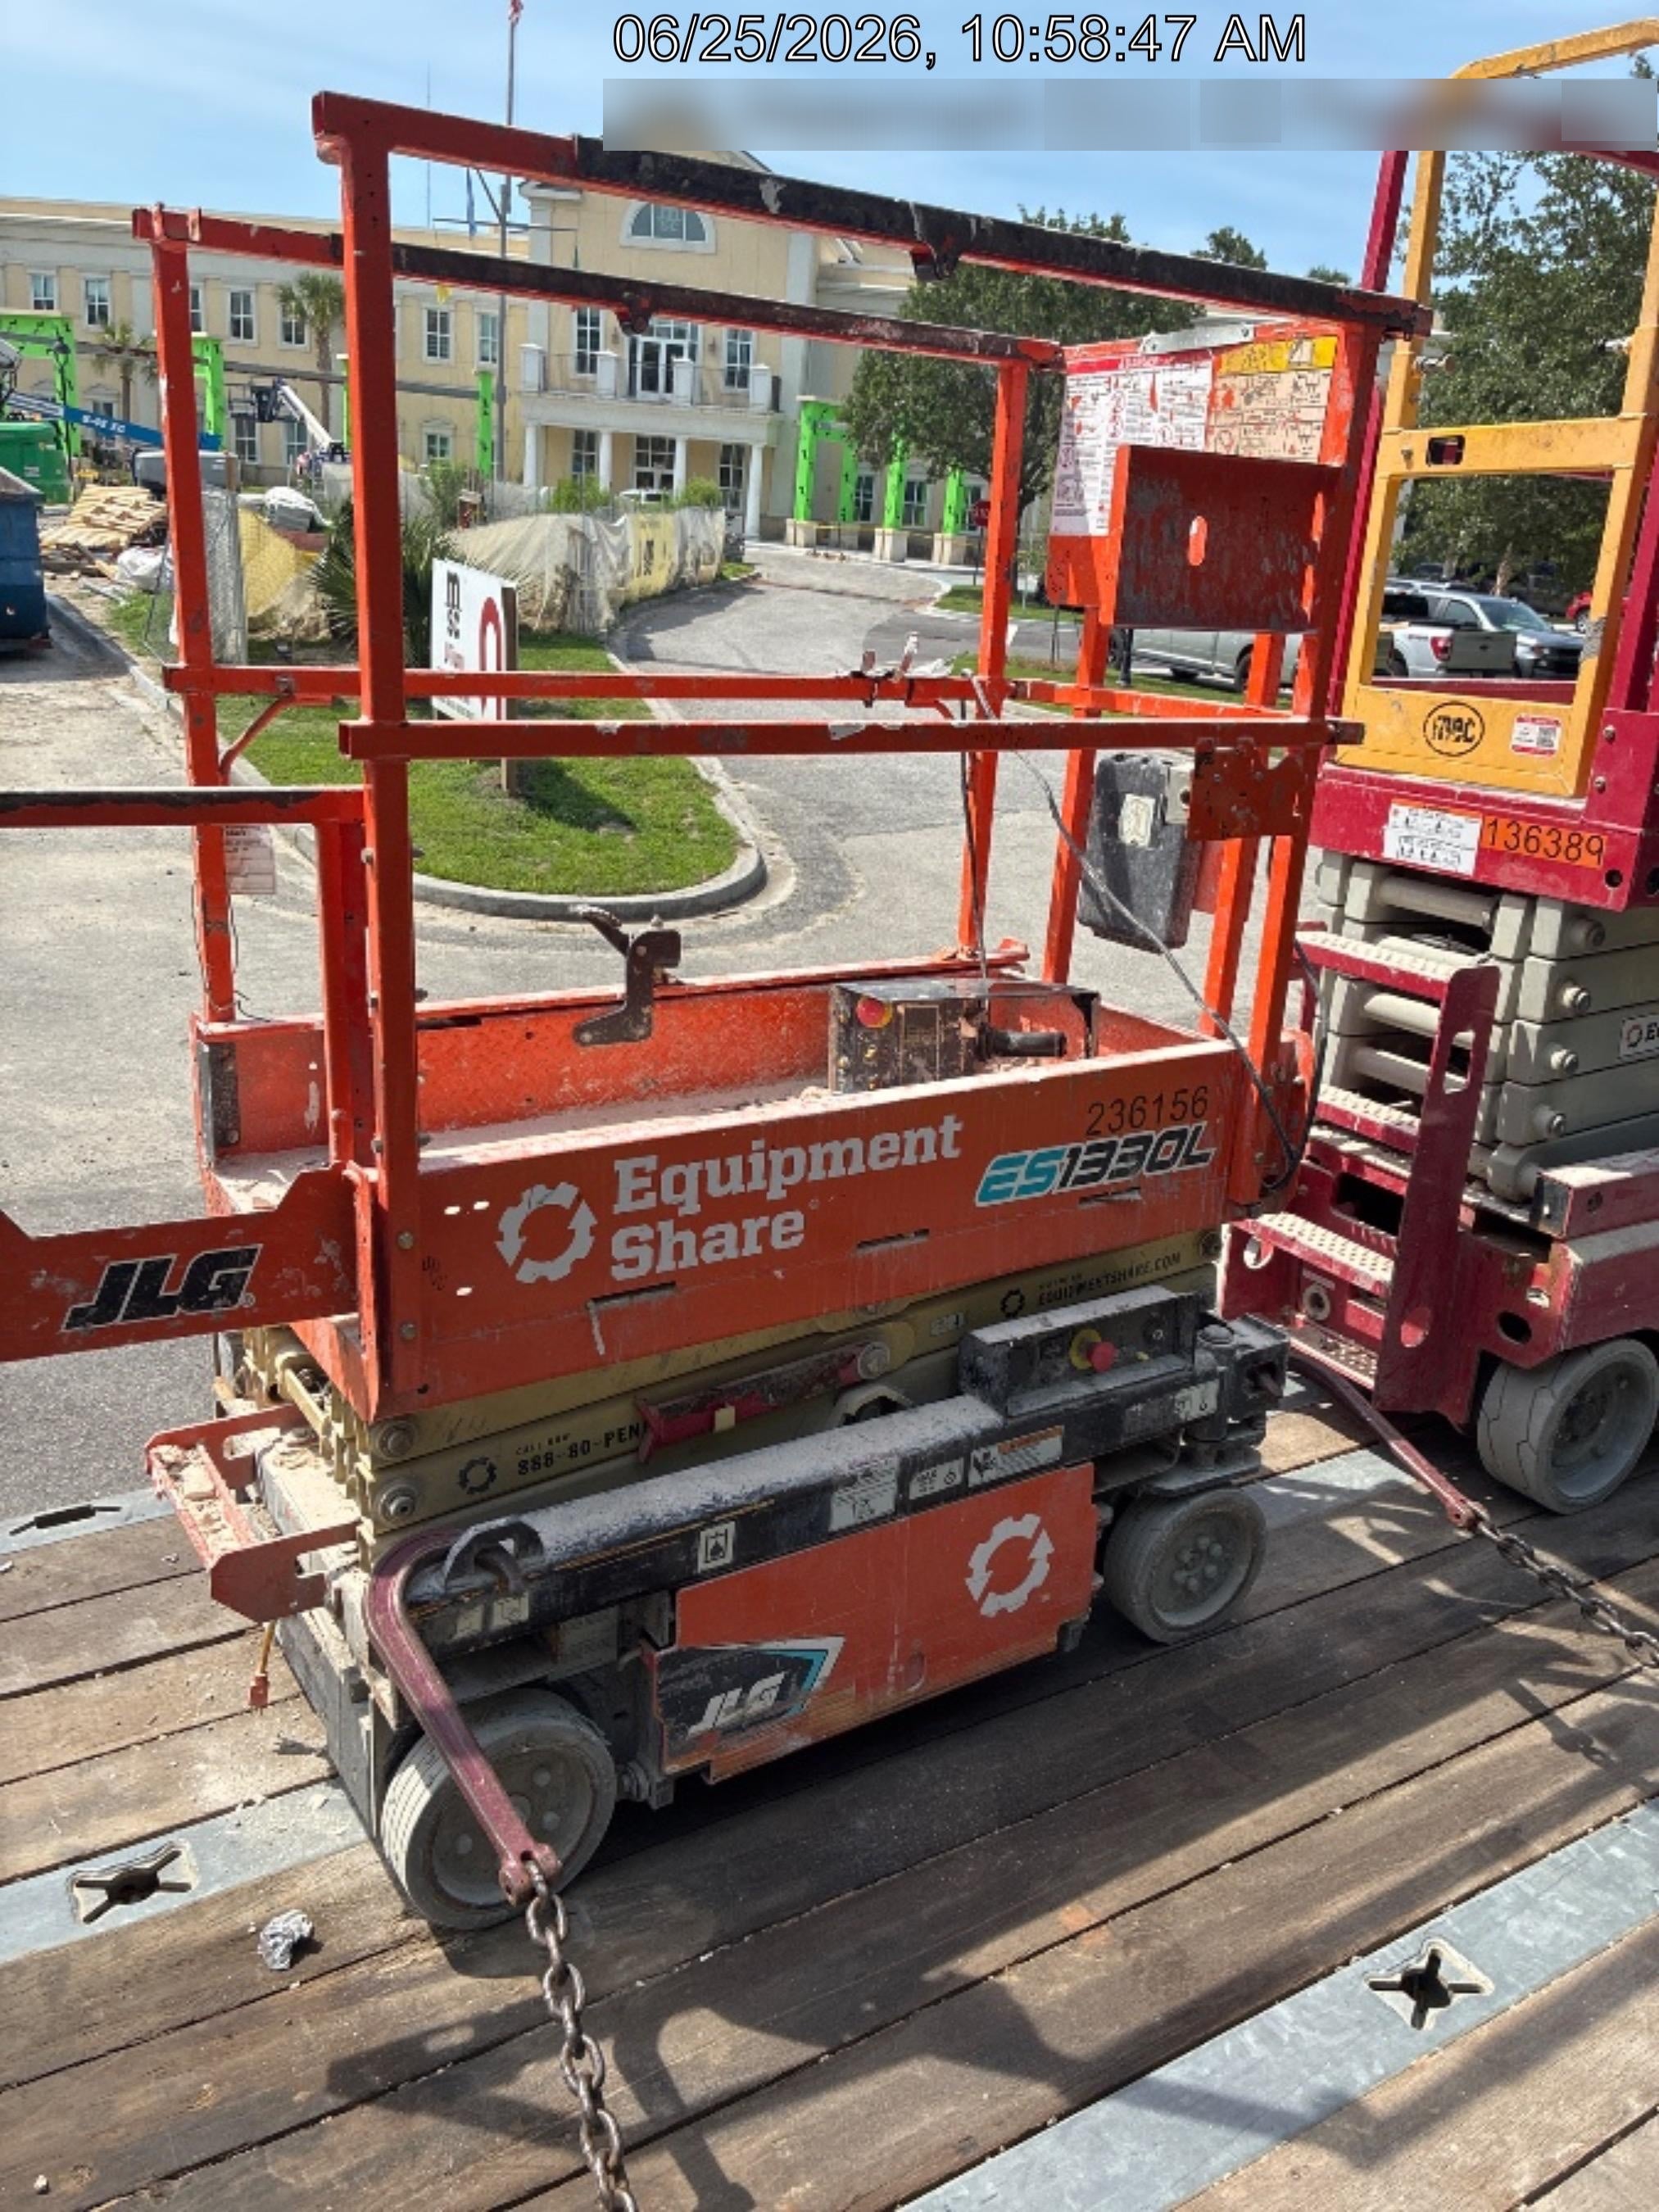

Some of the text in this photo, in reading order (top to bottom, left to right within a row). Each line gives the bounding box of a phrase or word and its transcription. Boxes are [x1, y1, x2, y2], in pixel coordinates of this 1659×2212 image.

[1486, 818, 1605, 866] 136389
[1086, 1086, 1208, 1136] 236156
[613, 1113, 963, 1217] Equipment
[975, 1121, 1217, 1207] ES1330L
[610, 1209, 805, 1281] Share
[60, 1243, 264, 1332] JLG
[685, 1670, 788, 1741] JLG
